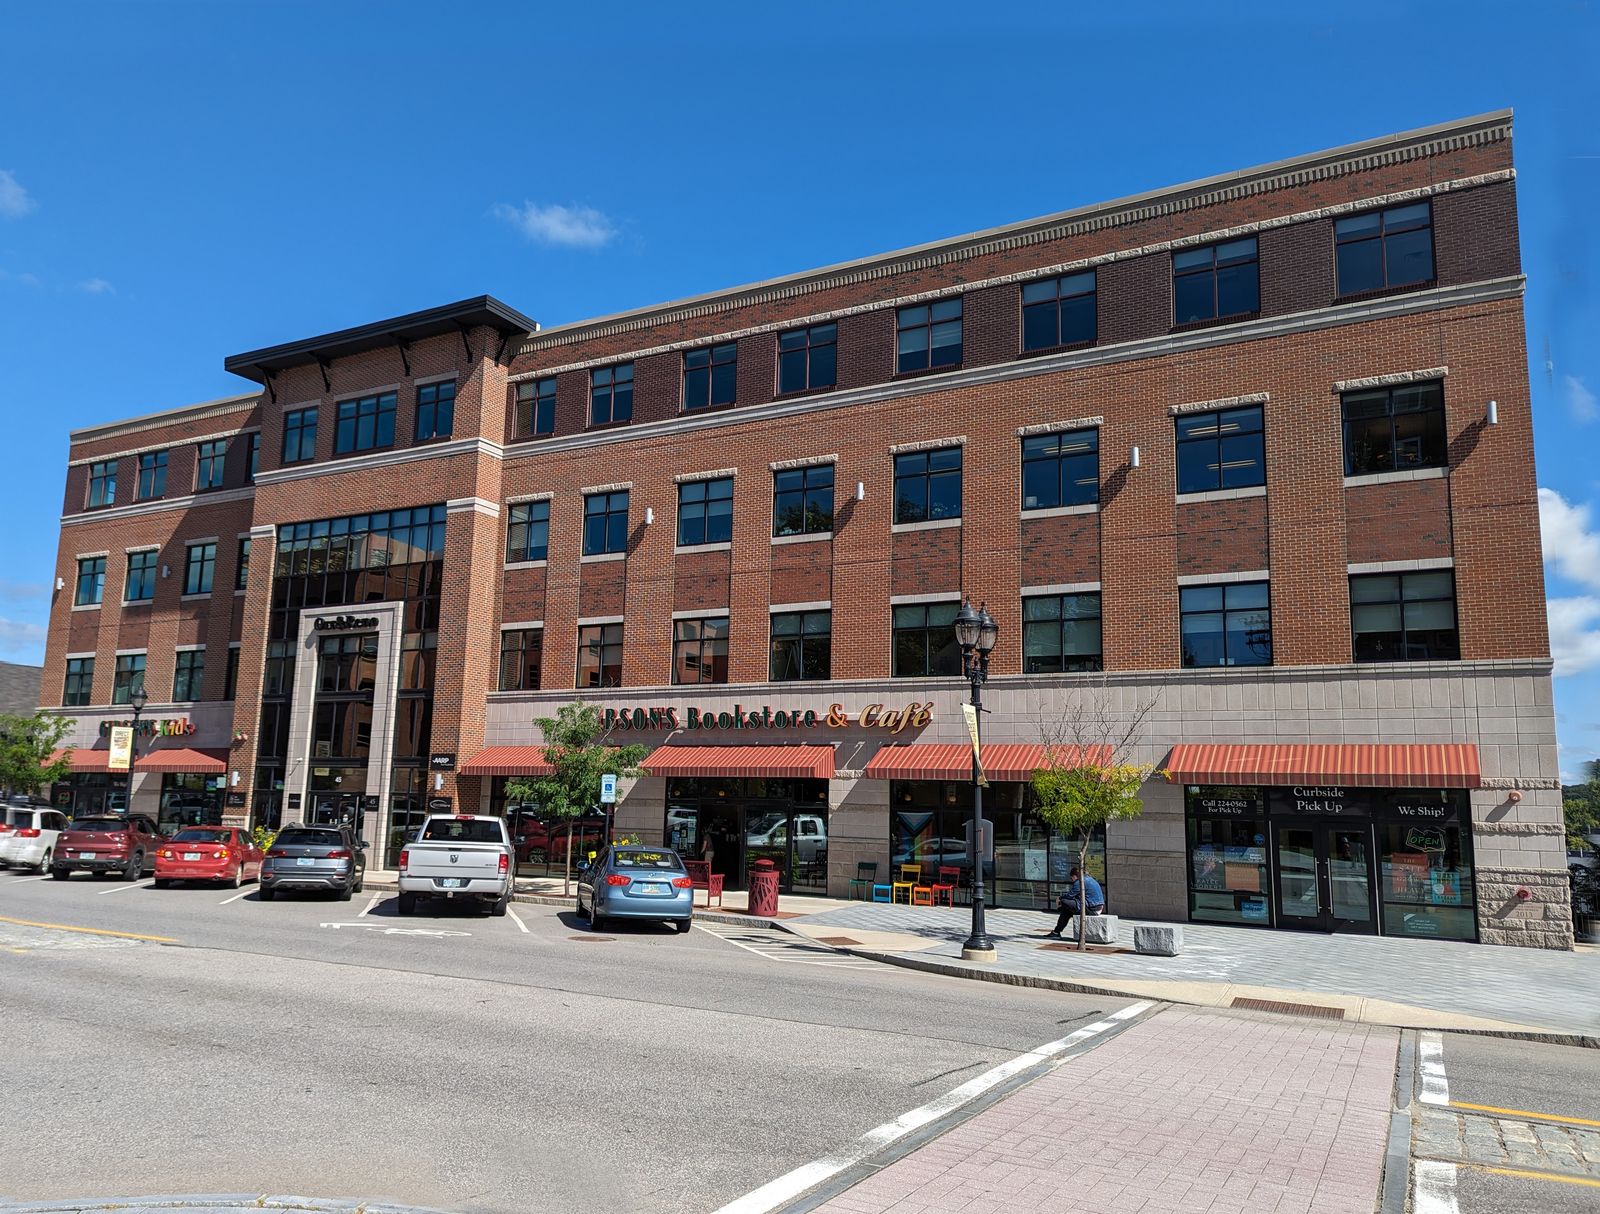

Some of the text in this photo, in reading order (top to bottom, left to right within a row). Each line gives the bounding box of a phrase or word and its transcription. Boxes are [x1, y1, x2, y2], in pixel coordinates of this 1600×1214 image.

[687, 704, 817, 730] Bookstore
[826, 703, 849, 728] &
[859, 701, 934, 735] Café
[1293, 786, 1344, 798] Curbside
[1202, 799, 1216, 807] Call
[1297, 800, 1343, 813] Pick Up
[1398, 806, 1444, 817] We Ship!
[1410, 836, 1440, 845] OPEN
